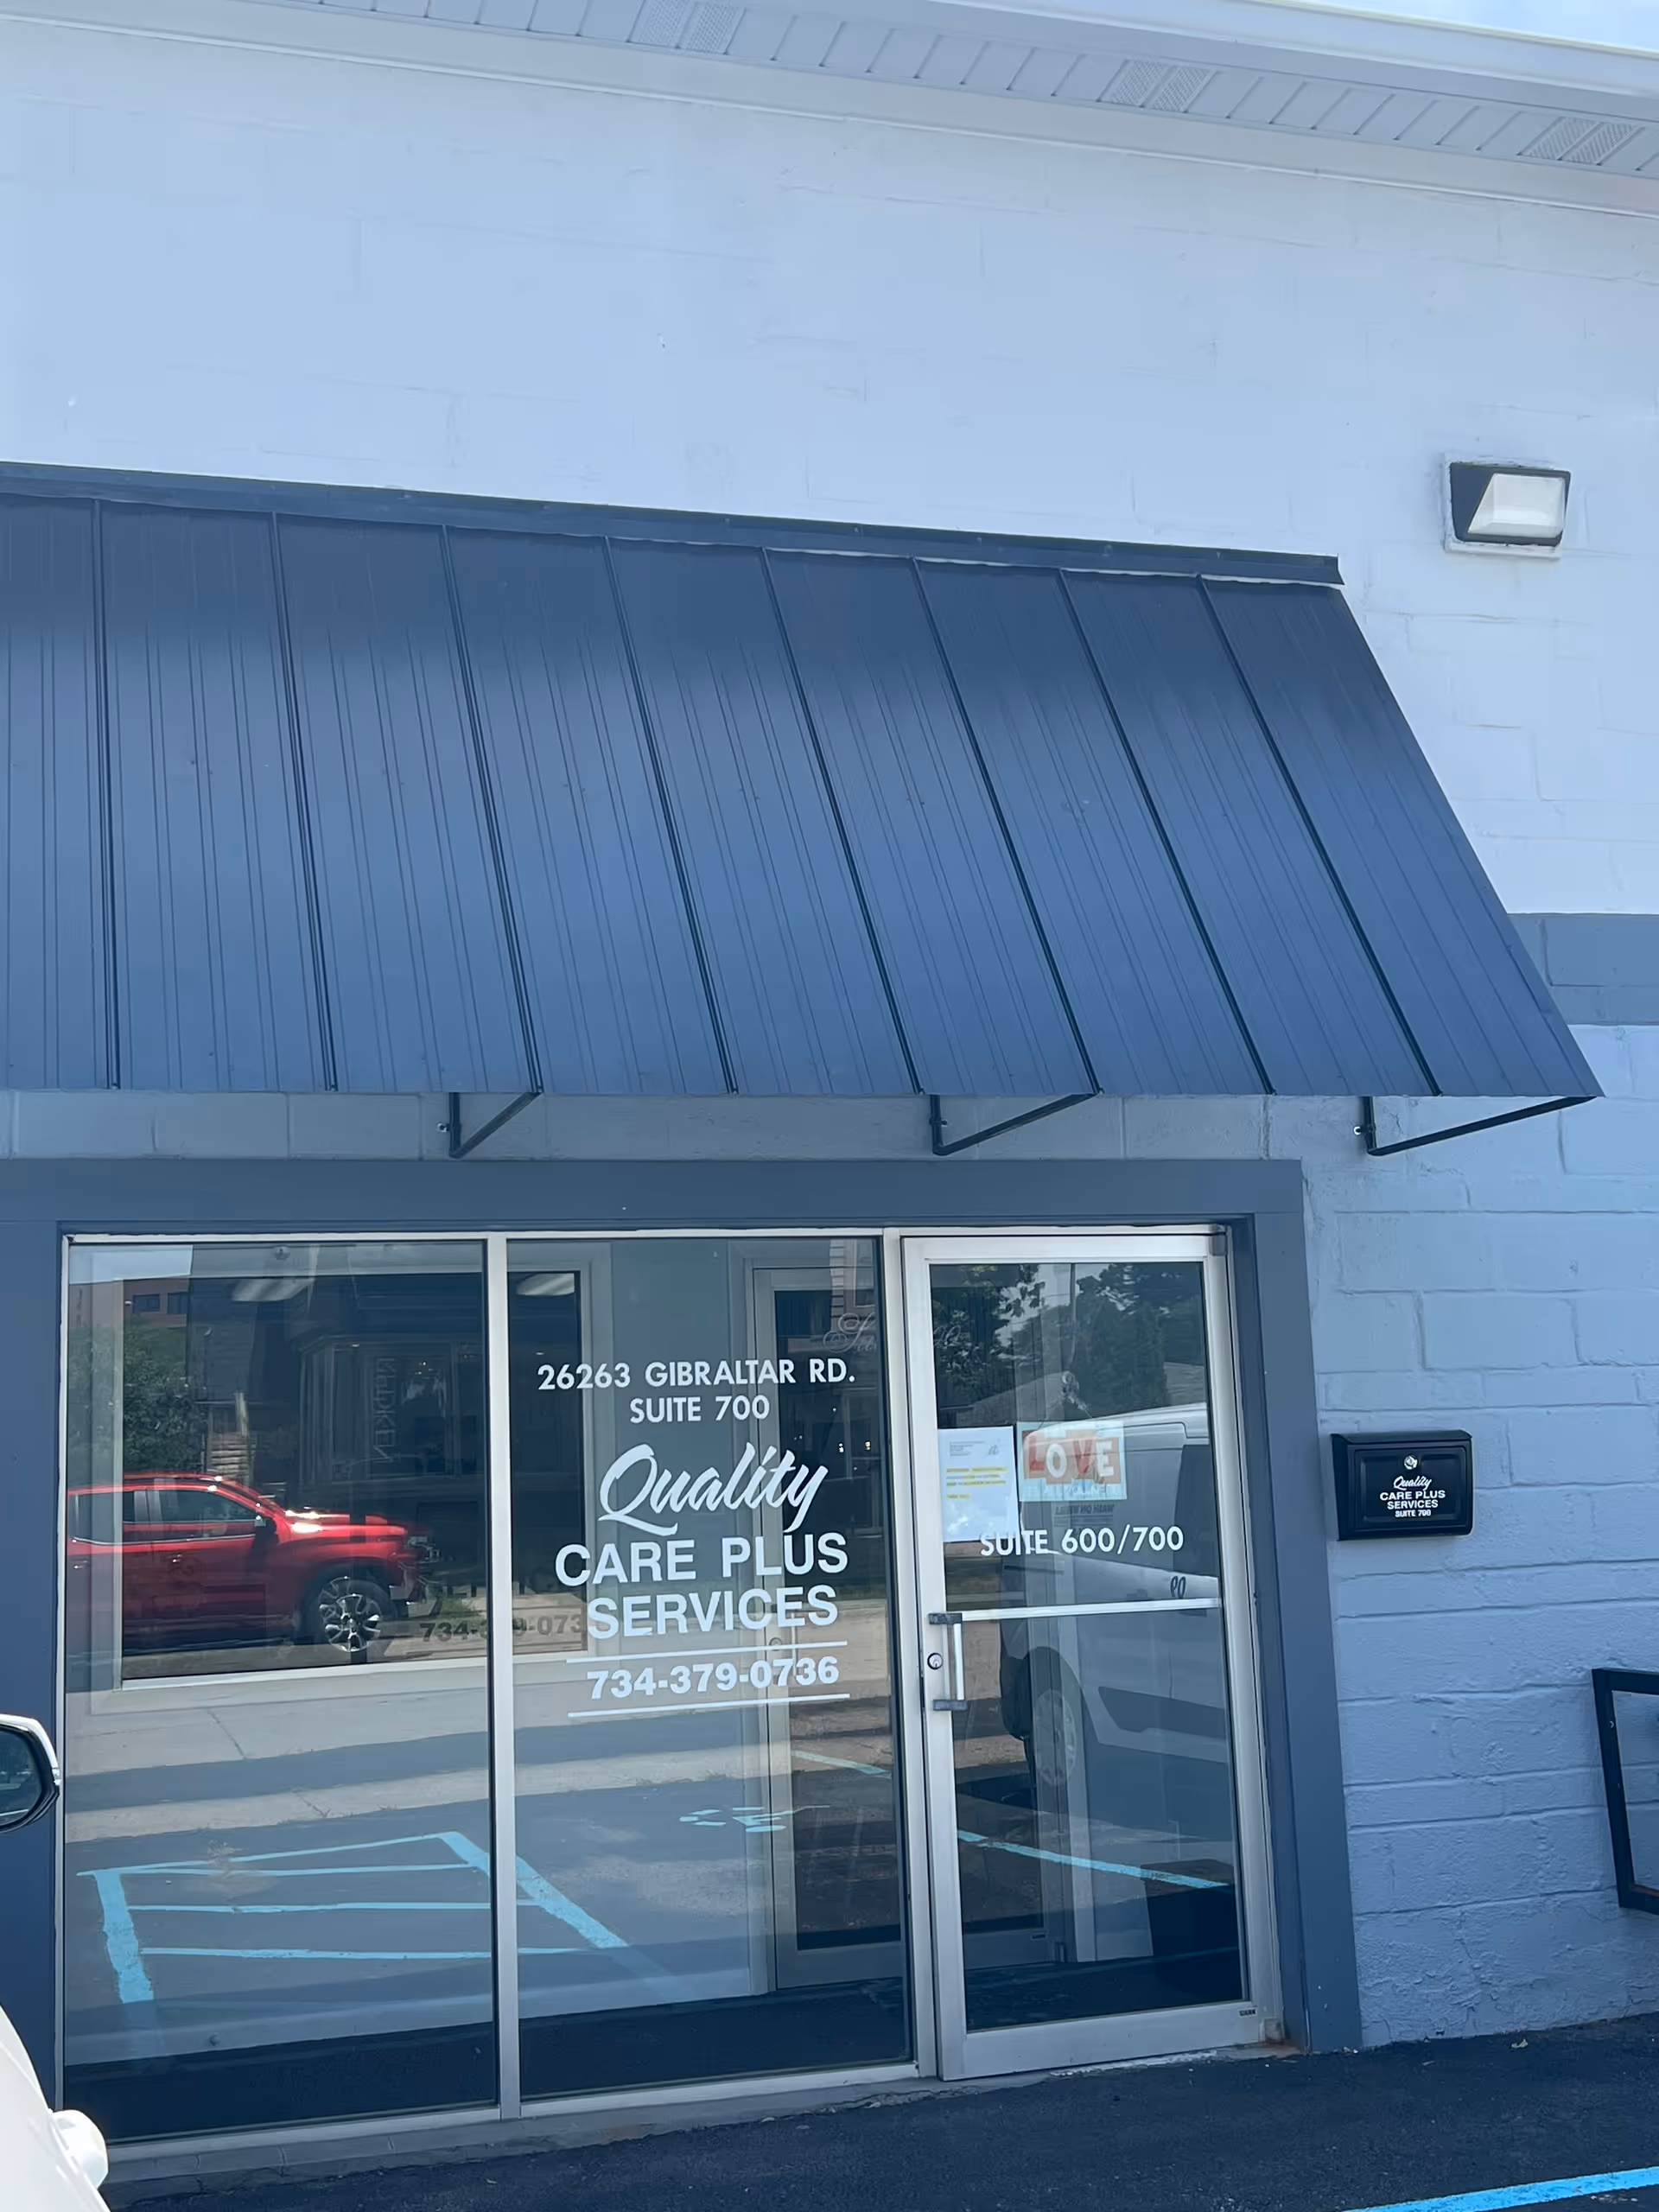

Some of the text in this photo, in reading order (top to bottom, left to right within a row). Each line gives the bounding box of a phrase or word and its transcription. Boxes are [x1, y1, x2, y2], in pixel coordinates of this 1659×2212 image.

[537, 1357, 856, 1390] 26263 GIBRALTAR RD.
[629, 1395, 770, 1424] SUITE 700
[1028, 1433, 1115, 1478] LOVE
[598, 1442, 829, 1536] Quality
[1379, 1490, 1446, 1501] CARE PLUS
[1393, 1475, 1433, 1491] Quality
[1387, 1499, 1439, 1510] SERVICES
[1418, 1509, 1432, 1517] 700
[980, 1523, 1185, 1556] SUITE 600/700
[555, 1532, 849, 1587] CARE PLUS
[587, 1584, 839, 1640] SERVICES
[586, 1655, 840, 1700] 734-379-0736
